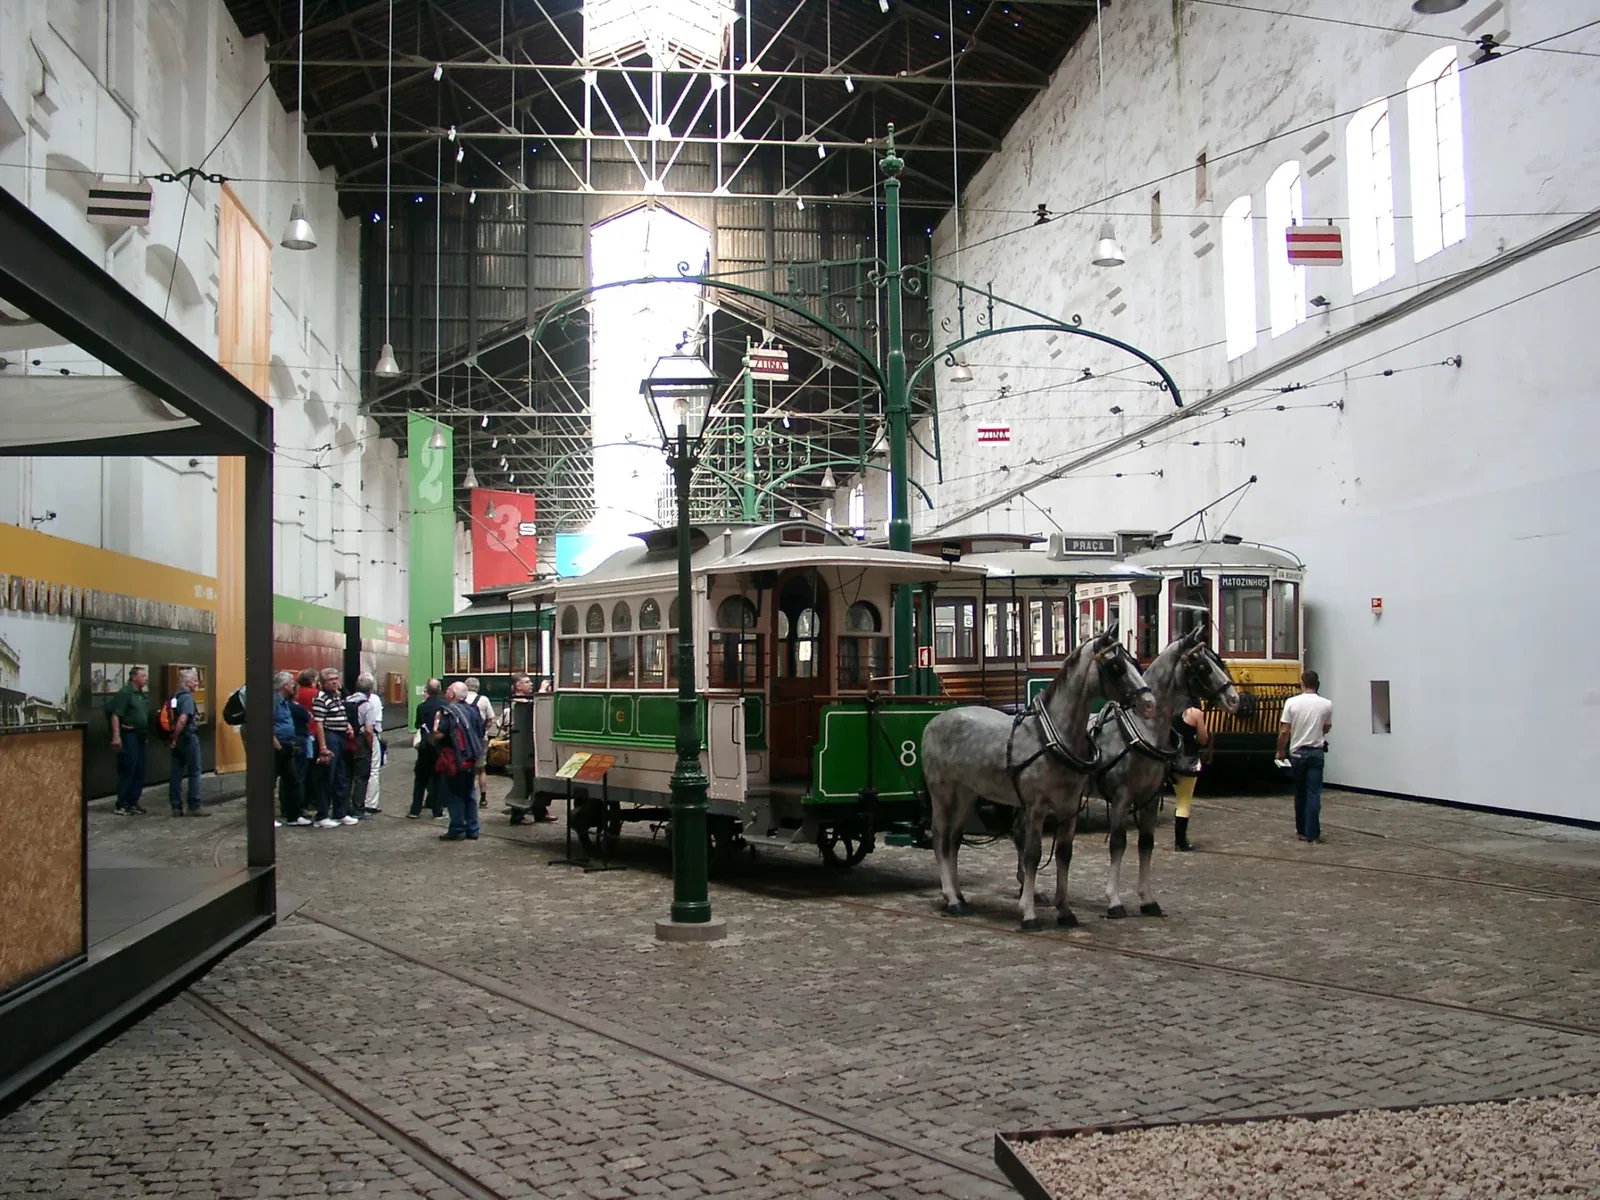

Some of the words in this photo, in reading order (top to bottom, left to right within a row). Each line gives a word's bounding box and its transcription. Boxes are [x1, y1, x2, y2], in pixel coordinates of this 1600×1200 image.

[418, 436, 444, 504] 2
[487, 504, 522, 552] 3
[1073, 541, 1105, 551] PRAÇA
[1186, 569, 1199, 586] 16
[1222, 577, 1268, 587] MATOZINHOS
[899, 740, 917, 767] 8
